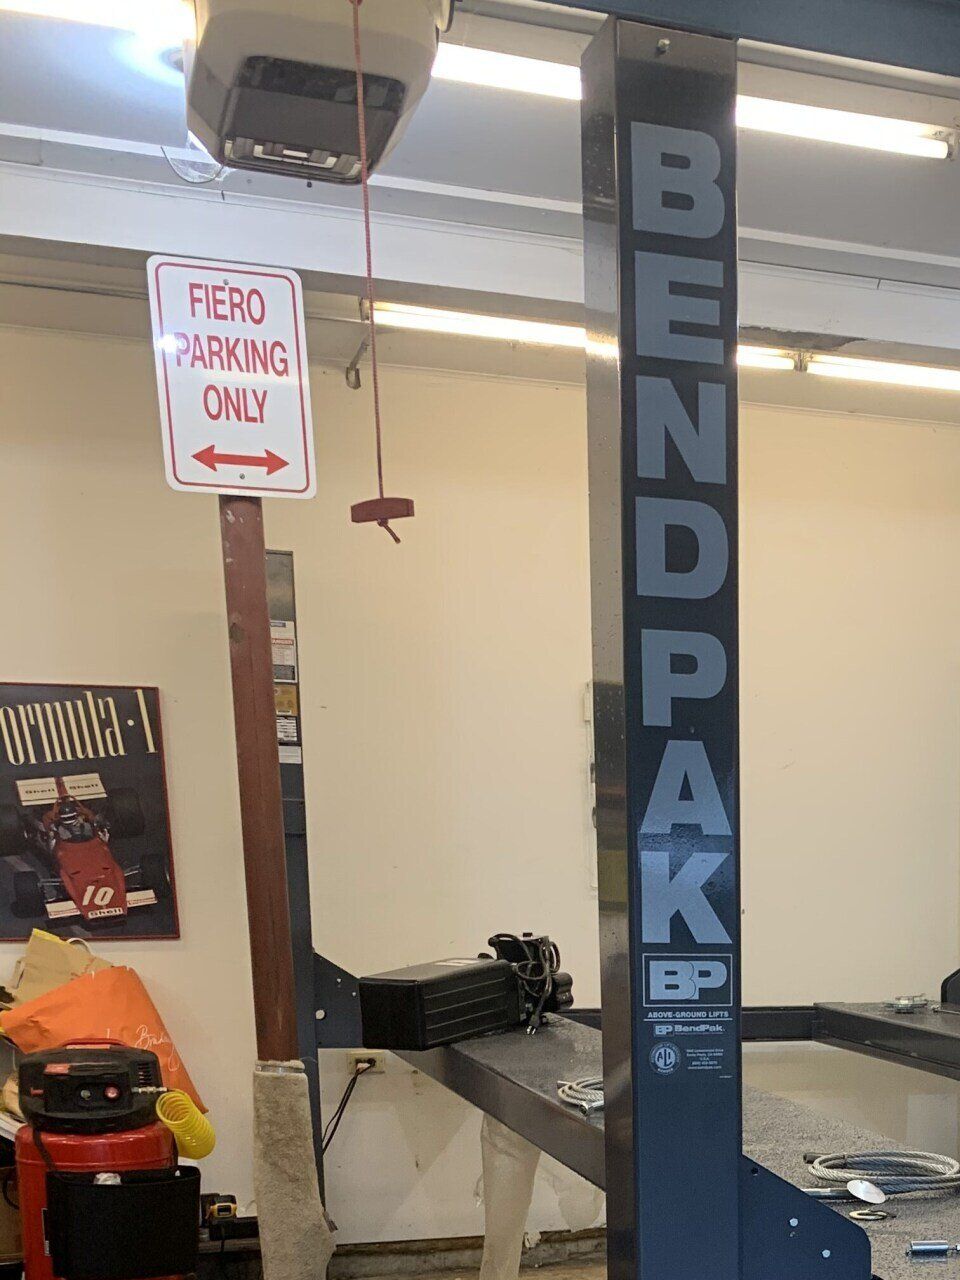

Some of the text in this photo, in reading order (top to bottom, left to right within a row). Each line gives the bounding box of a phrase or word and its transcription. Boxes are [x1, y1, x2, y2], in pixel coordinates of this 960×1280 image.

[189, 282, 265, 325] FIERO
[174, 332, 289, 377] PARKING
[203, 384, 268, 423] ONLY
[631, 121, 733, 943] BENDPAK
[82, 885, 115, 906] 10
[90, 908, 122, 917] Shell
[649, 960, 728, 1000] BP
